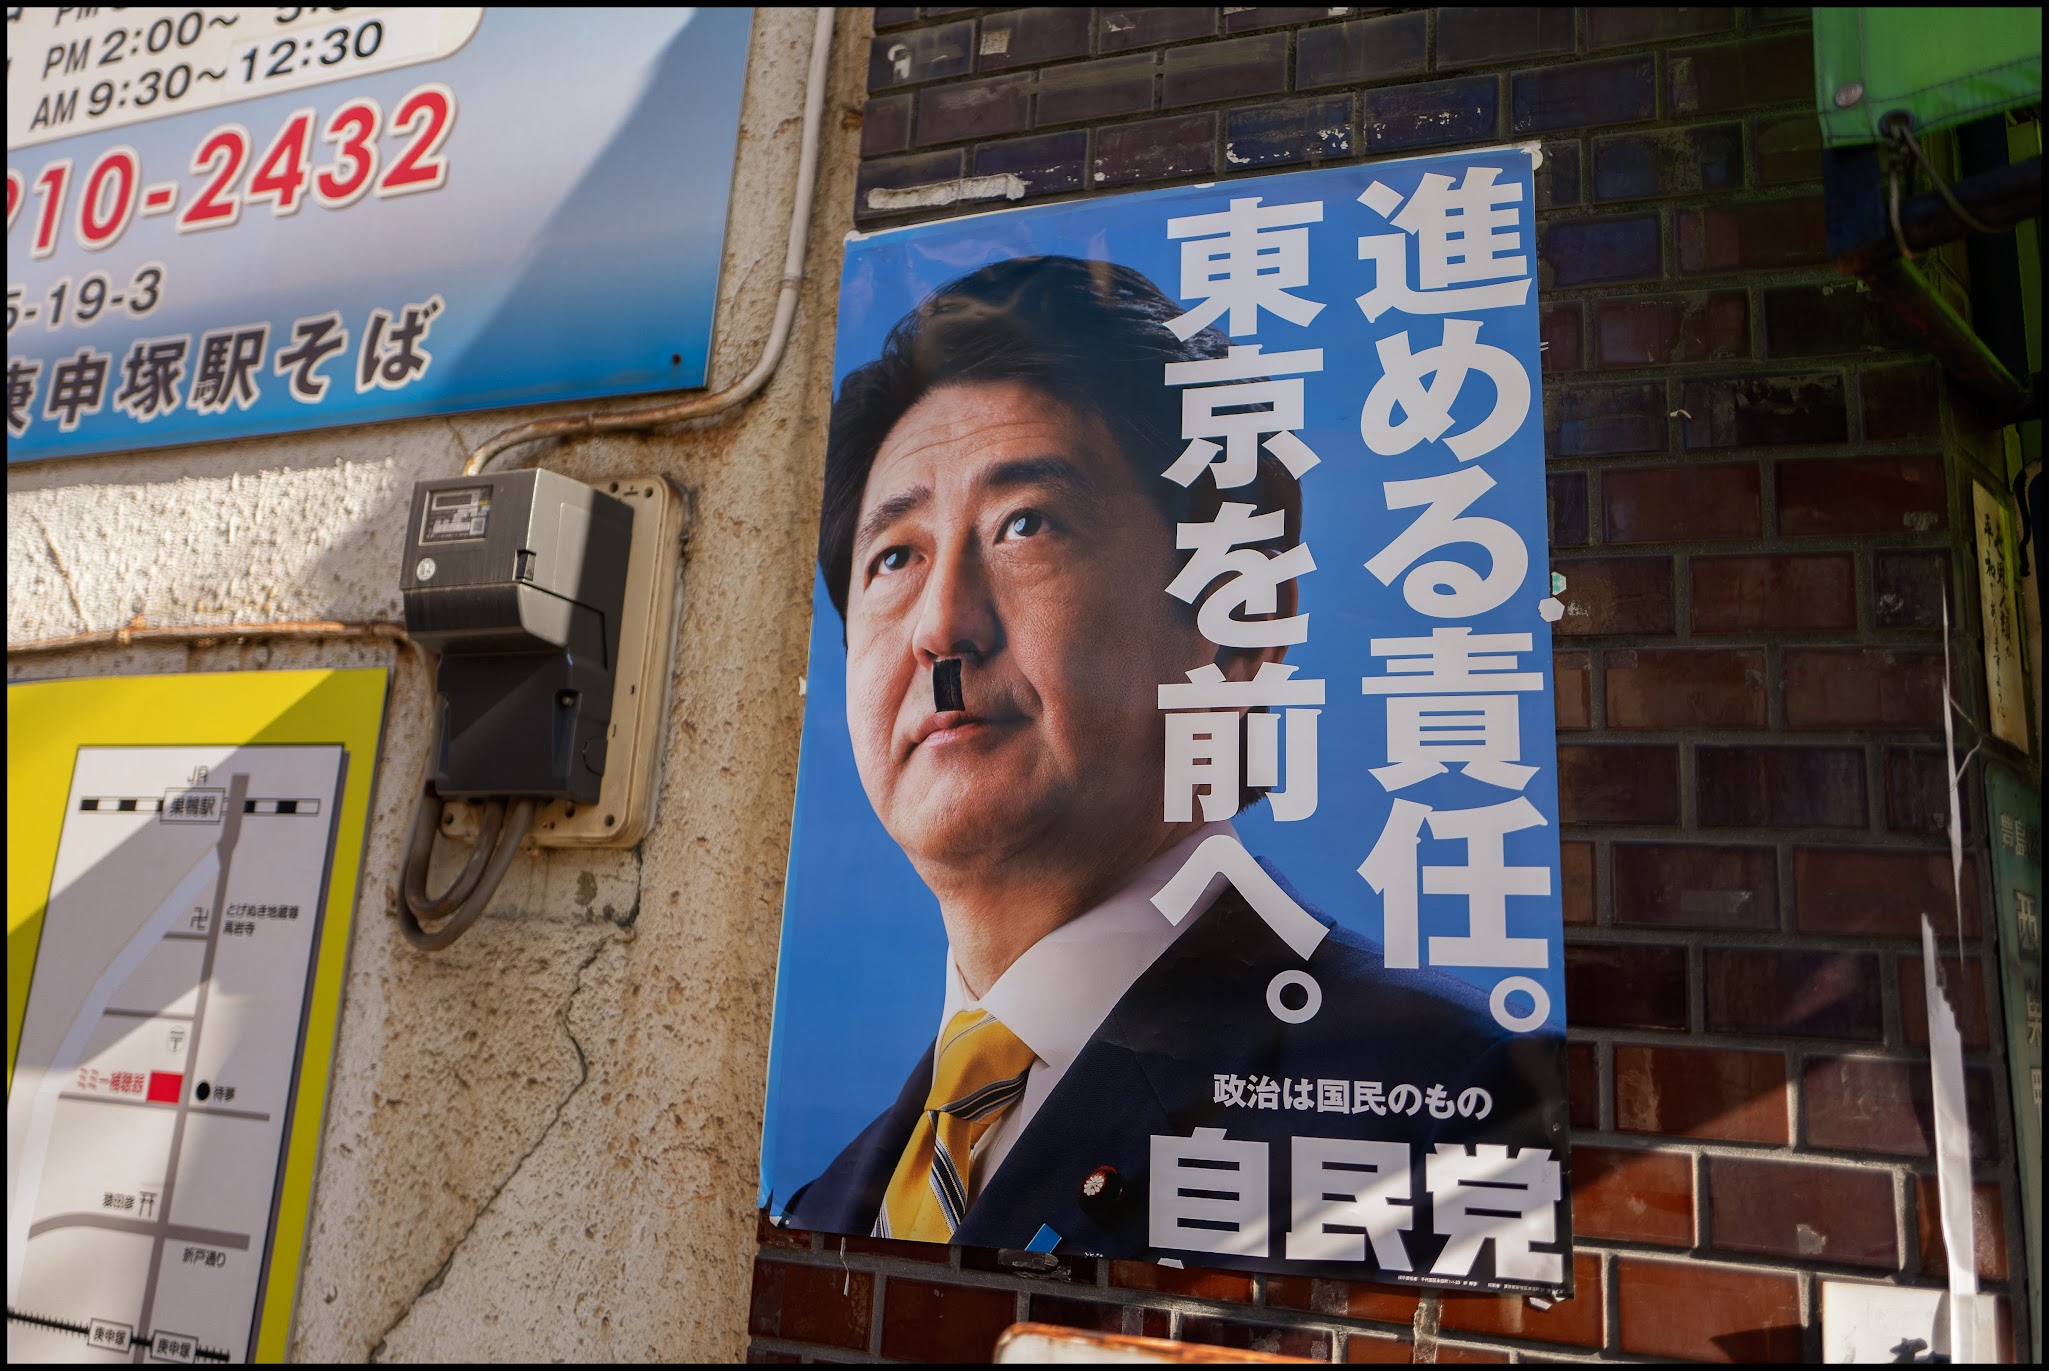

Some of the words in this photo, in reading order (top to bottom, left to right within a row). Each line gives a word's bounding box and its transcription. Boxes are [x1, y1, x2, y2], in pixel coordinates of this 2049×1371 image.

[28, 88, 80, 132] AM
[42, 37, 93, 81] PM
[8, 90, 451, 251] 10-2432
[1149, 195, 1333, 1026] 東京を前へ。
[1356, 166, 1553, 1035] 進める責任。
[1213, 1073, 1493, 1120] 政治は国民のもの
[1148, 1127, 1566, 1283] 自民党
